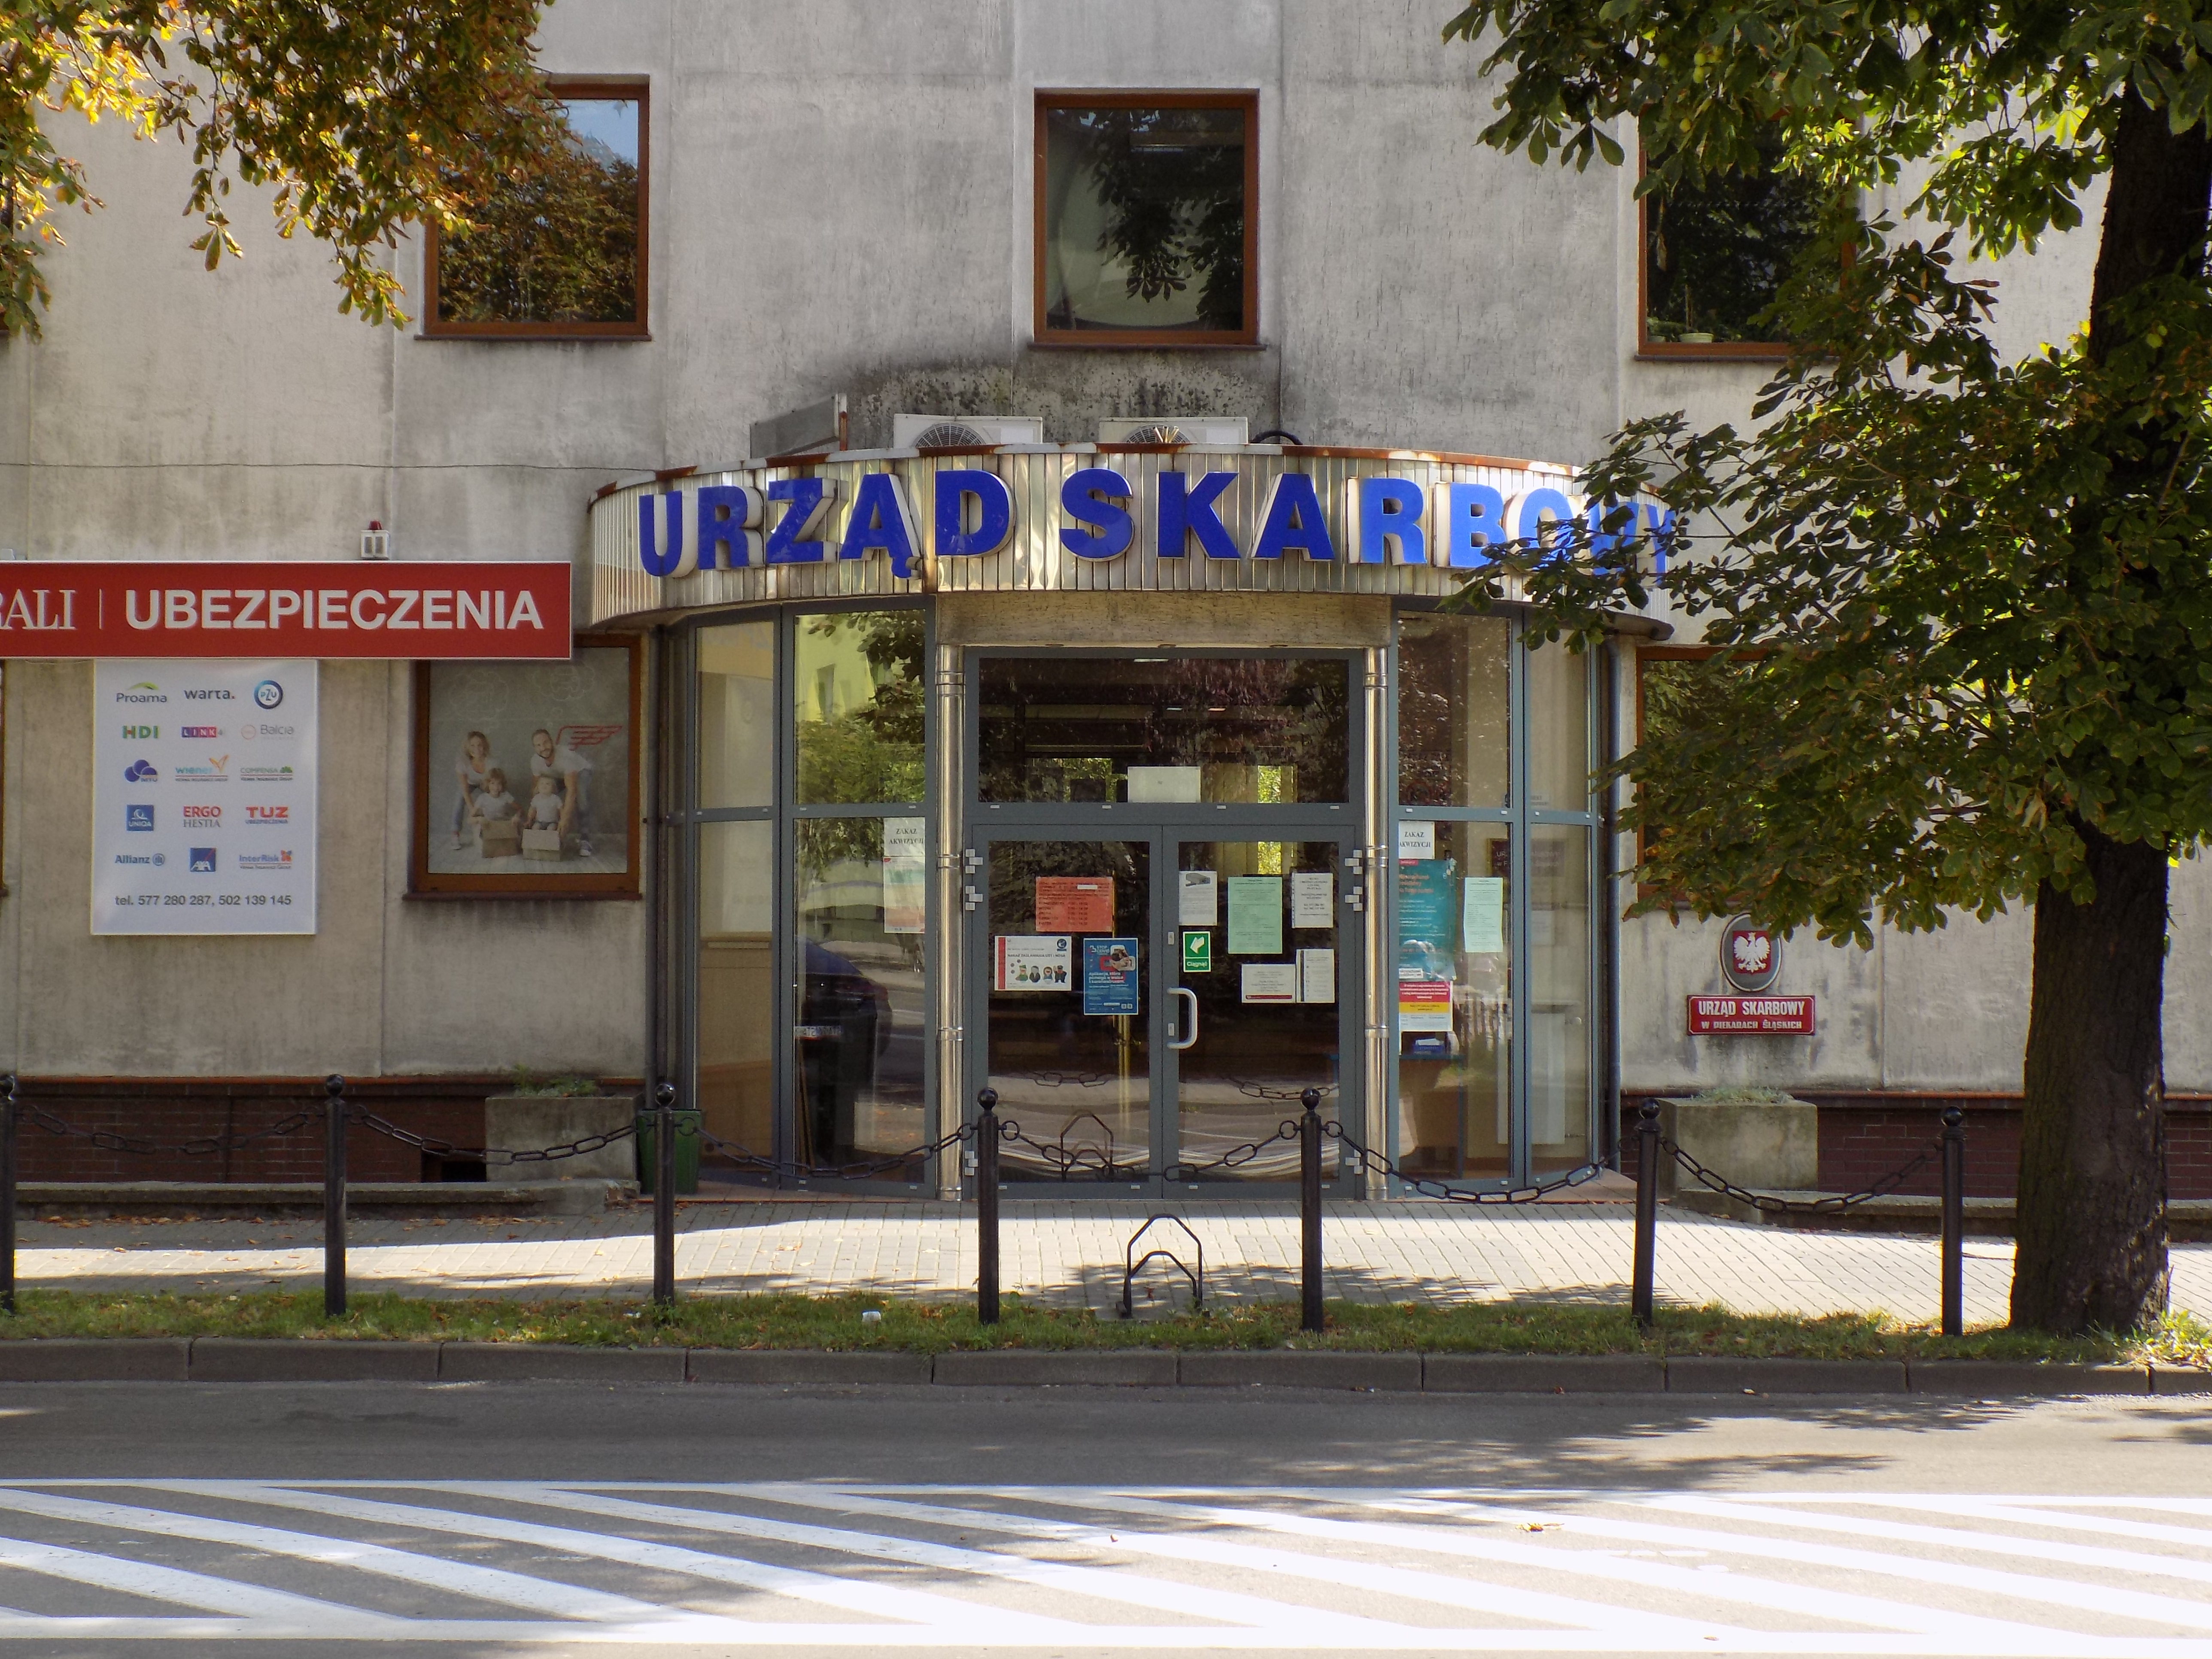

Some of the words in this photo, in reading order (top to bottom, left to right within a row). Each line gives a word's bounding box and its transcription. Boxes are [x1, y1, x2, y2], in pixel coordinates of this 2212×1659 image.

[638, 469, 1015, 579] URZĄD
[0, 588, 76, 630] ALI
[125, 589, 544, 630] UBEZPIECZENIA
[116, 693, 167, 702] Proama
[260, 689, 277, 701] PZU
[122, 725, 158, 738] HDI
[260, 724, 294, 735] Balcia
[183, 806, 221, 817] ERGO
[246, 806, 288, 818] TUZ
[183, 819, 221, 827] HESTIA
[115, 855, 150, 863] Allianz
[191, 860, 211, 871] AXA
[115, 895, 134, 905] tel.
[138, 895, 160, 905] 577
[164, 895, 185, 905] 280
[189, 895, 215, 906] 287,
[219, 895, 240, 905] 502
[245, 895, 266, 905] 139
[271, 895, 292, 905] 145
[1698, 1001, 1736, 1018] URZĄD
[1742, 1001, 1805, 1016] SKARBOWY
[1701, 1021, 1710, 1029] W
[1762, 1019, 1802, 1030] ŚLĄSKICH
